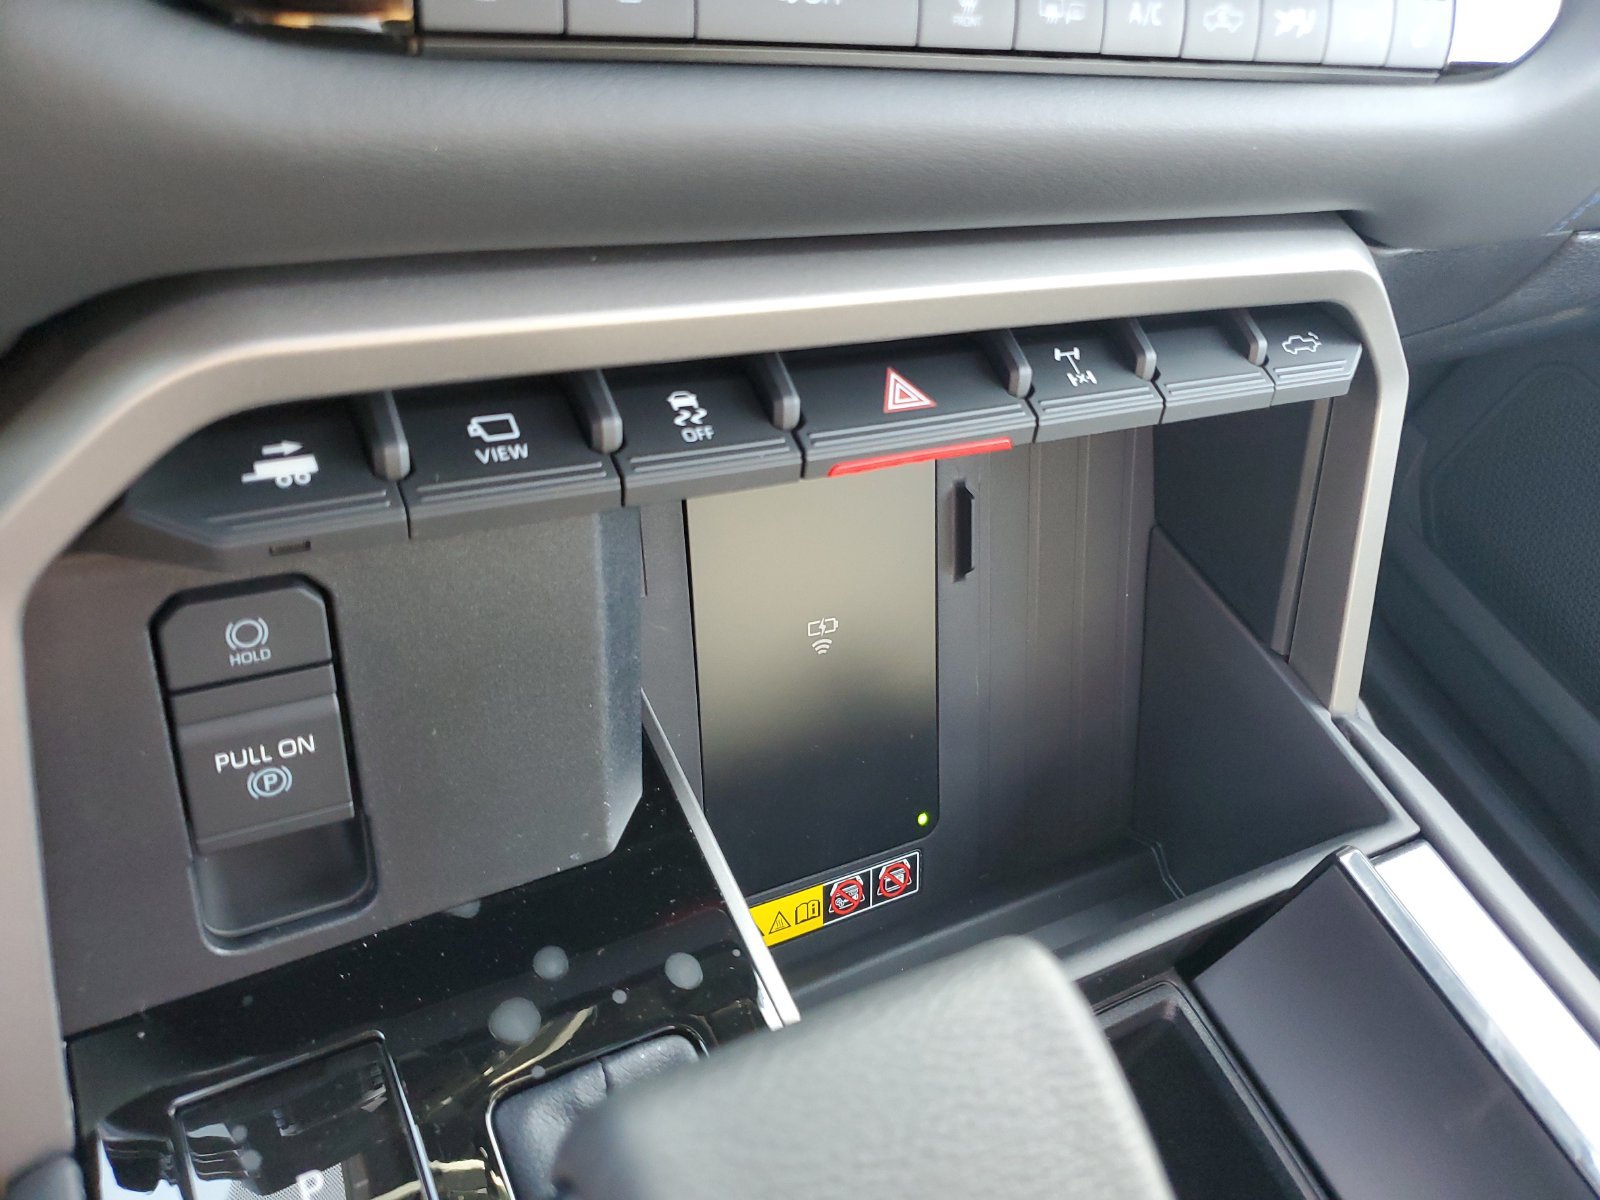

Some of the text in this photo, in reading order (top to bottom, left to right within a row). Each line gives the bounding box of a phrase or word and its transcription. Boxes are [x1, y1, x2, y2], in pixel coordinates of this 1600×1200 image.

[1128, 2, 1162, 27] A/C
[681, 425, 715, 443] OFF
[474, 442, 529, 465] VIEW
[229, 648, 272, 667] HOLD
[214, 733, 316, 774] PULL ON
[263, 773, 278, 792] P
[296, 1169, 324, 1200] P
